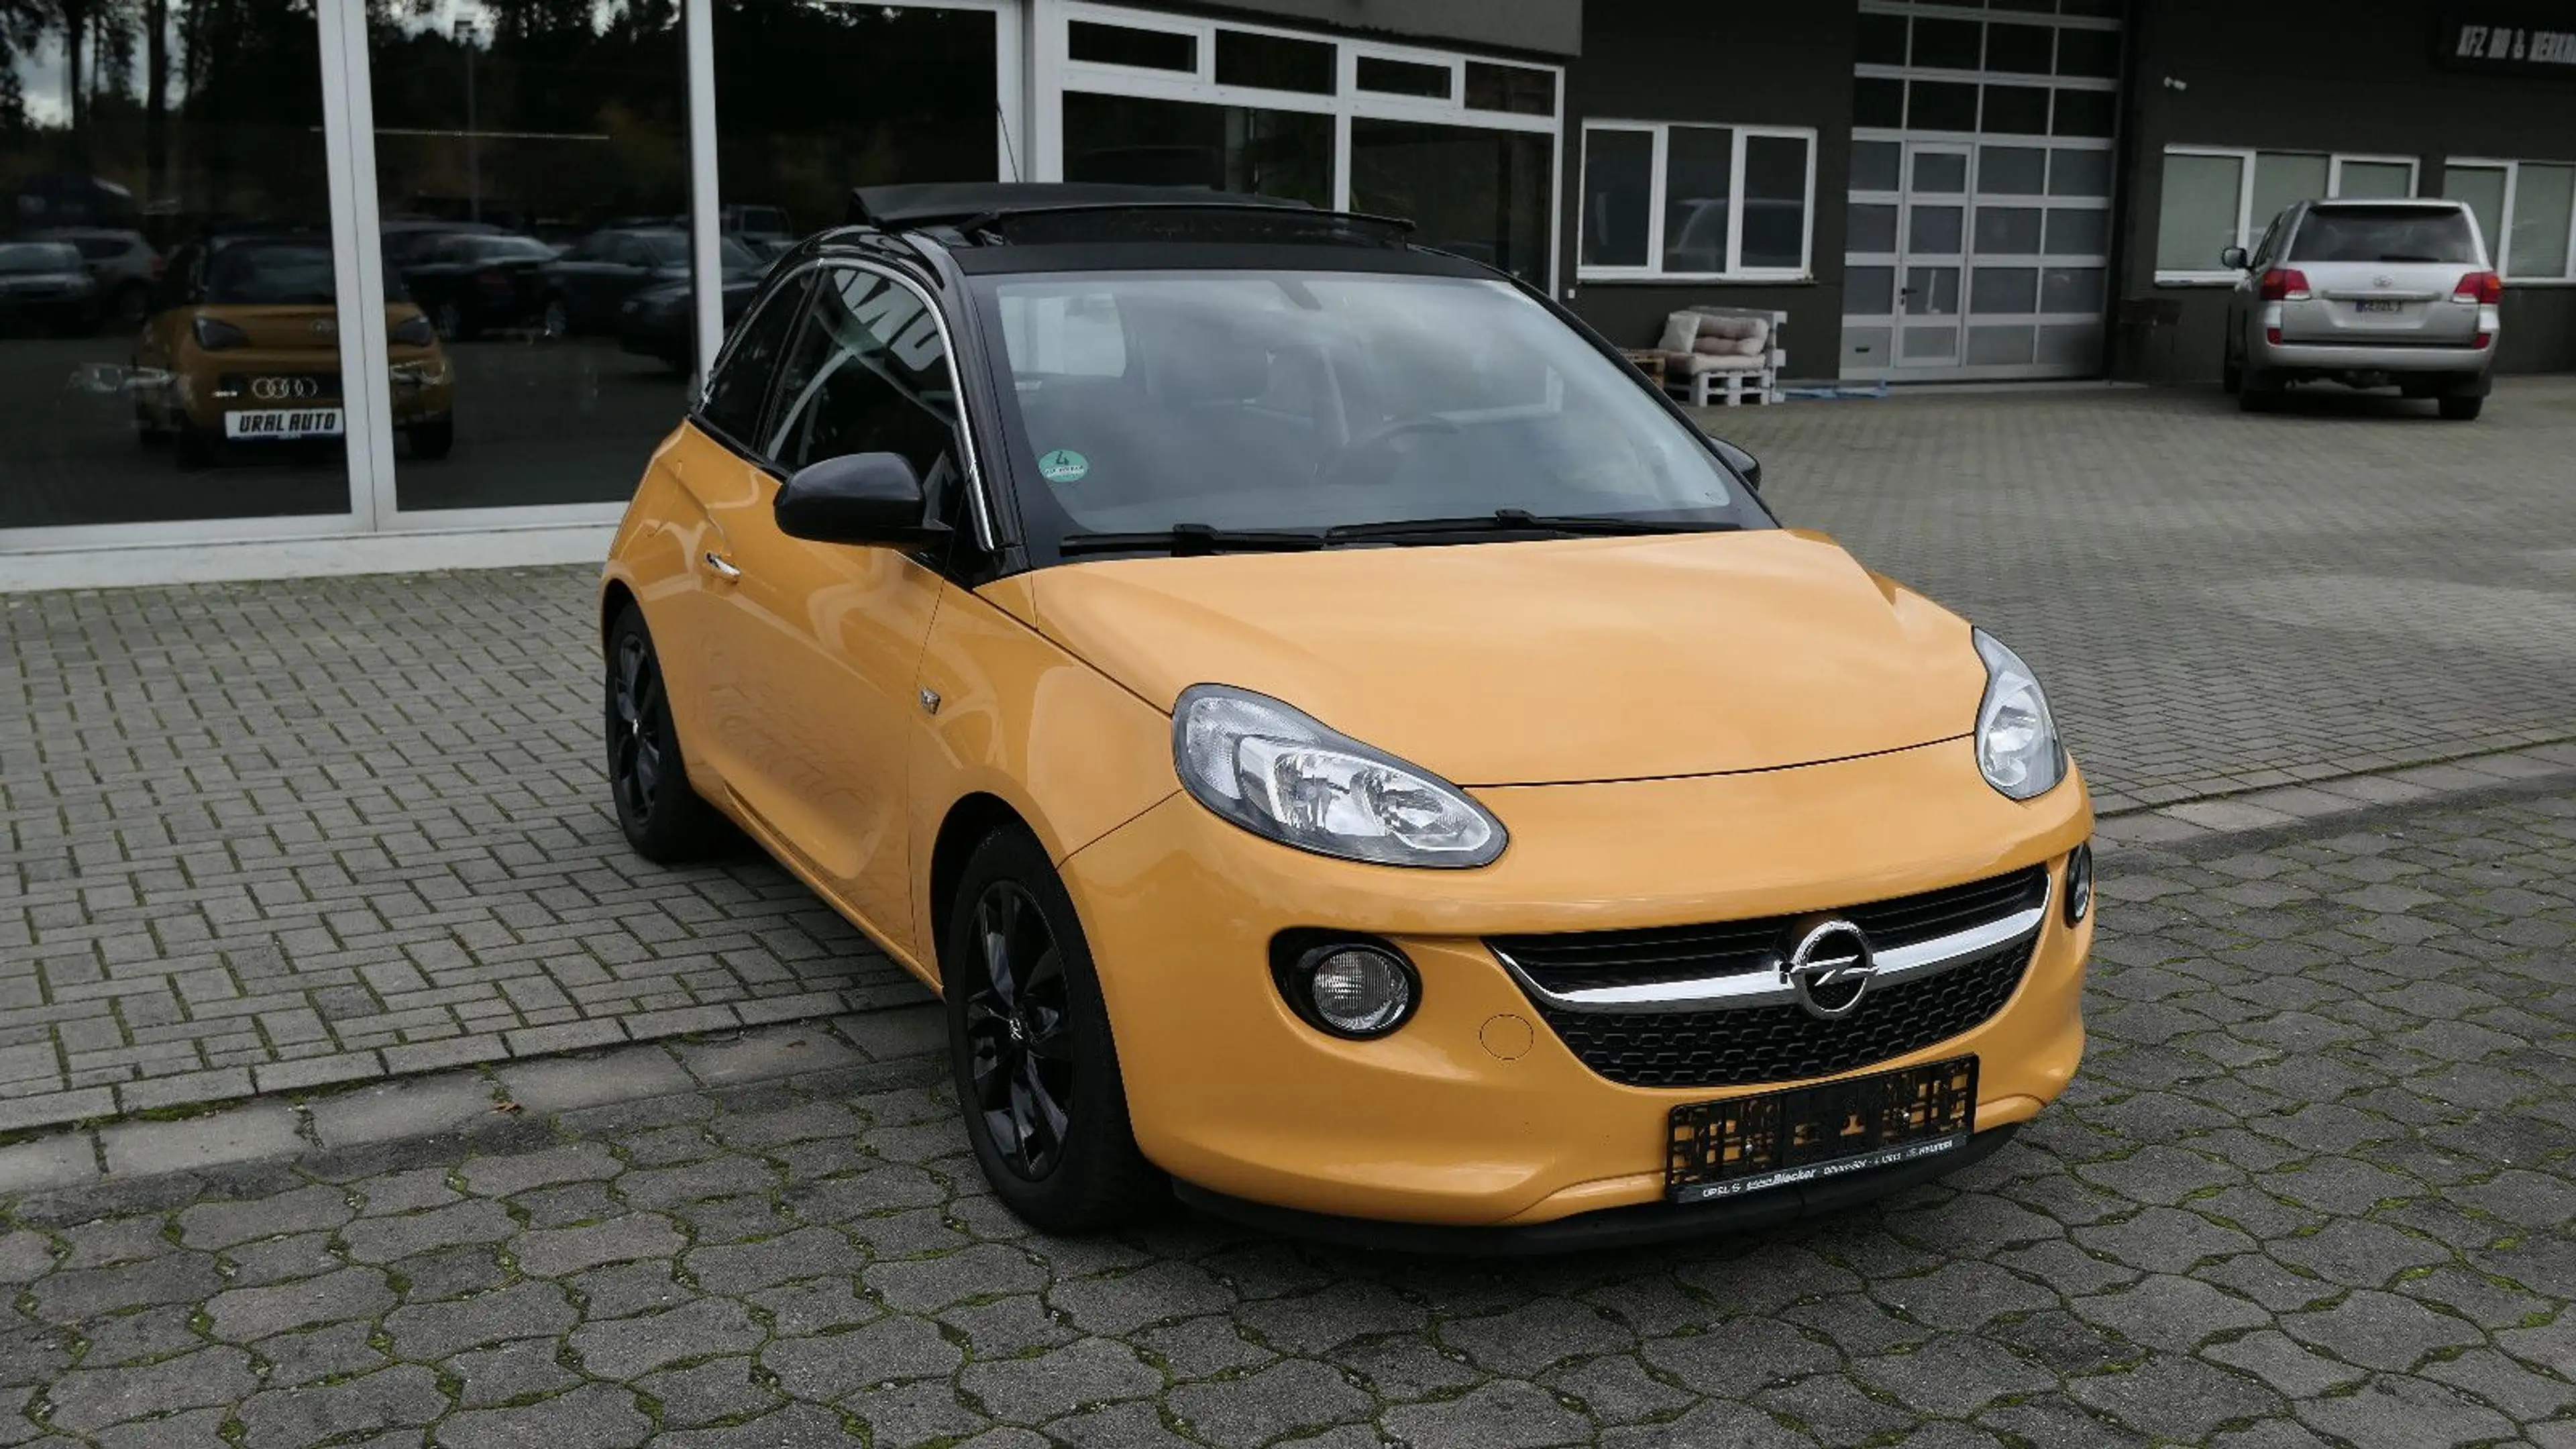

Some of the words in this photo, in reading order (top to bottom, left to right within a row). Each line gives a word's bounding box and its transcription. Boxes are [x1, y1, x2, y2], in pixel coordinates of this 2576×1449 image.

[2457, 25, 2488, 57] KFZ
[239, 413, 284, 433] URAL
[288, 413, 335, 431] AUTO
[1055, 450, 1070, 465] 4
